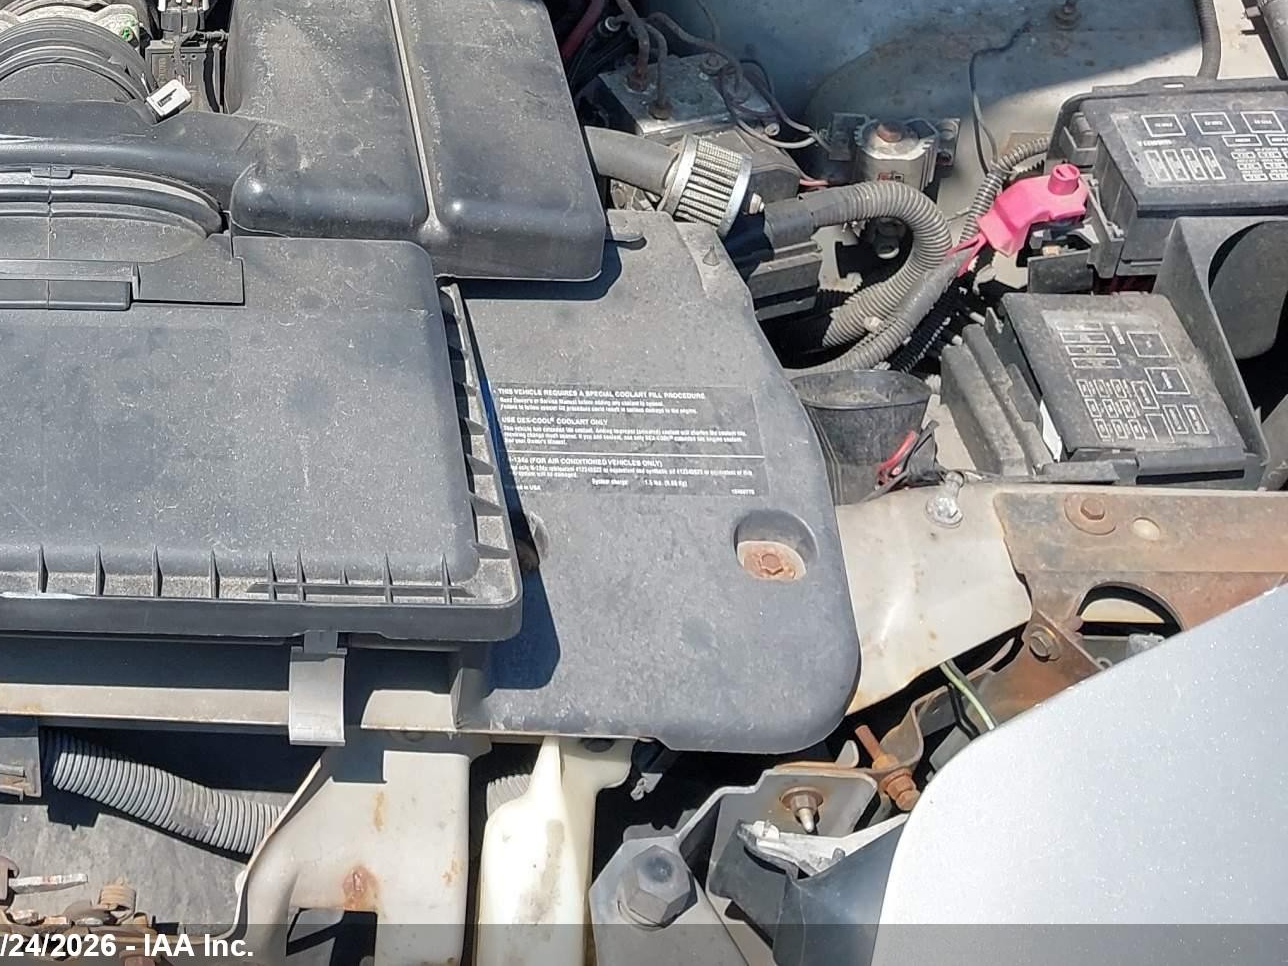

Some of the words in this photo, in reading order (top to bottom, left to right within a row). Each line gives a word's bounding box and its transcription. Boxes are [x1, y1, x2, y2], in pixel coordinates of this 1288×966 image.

[514, 388, 543, 396] VEHICLE
[543, 389, 578, 397] REQUIRES
[585, 390, 614, 398] SPECIAL
[529, 457, 547, 465] (FOR
[548, 457, 560, 465] AIR
[560, 458, 607, 466] CONDITIONED
[642, 460, 663, 468] ONLY)
